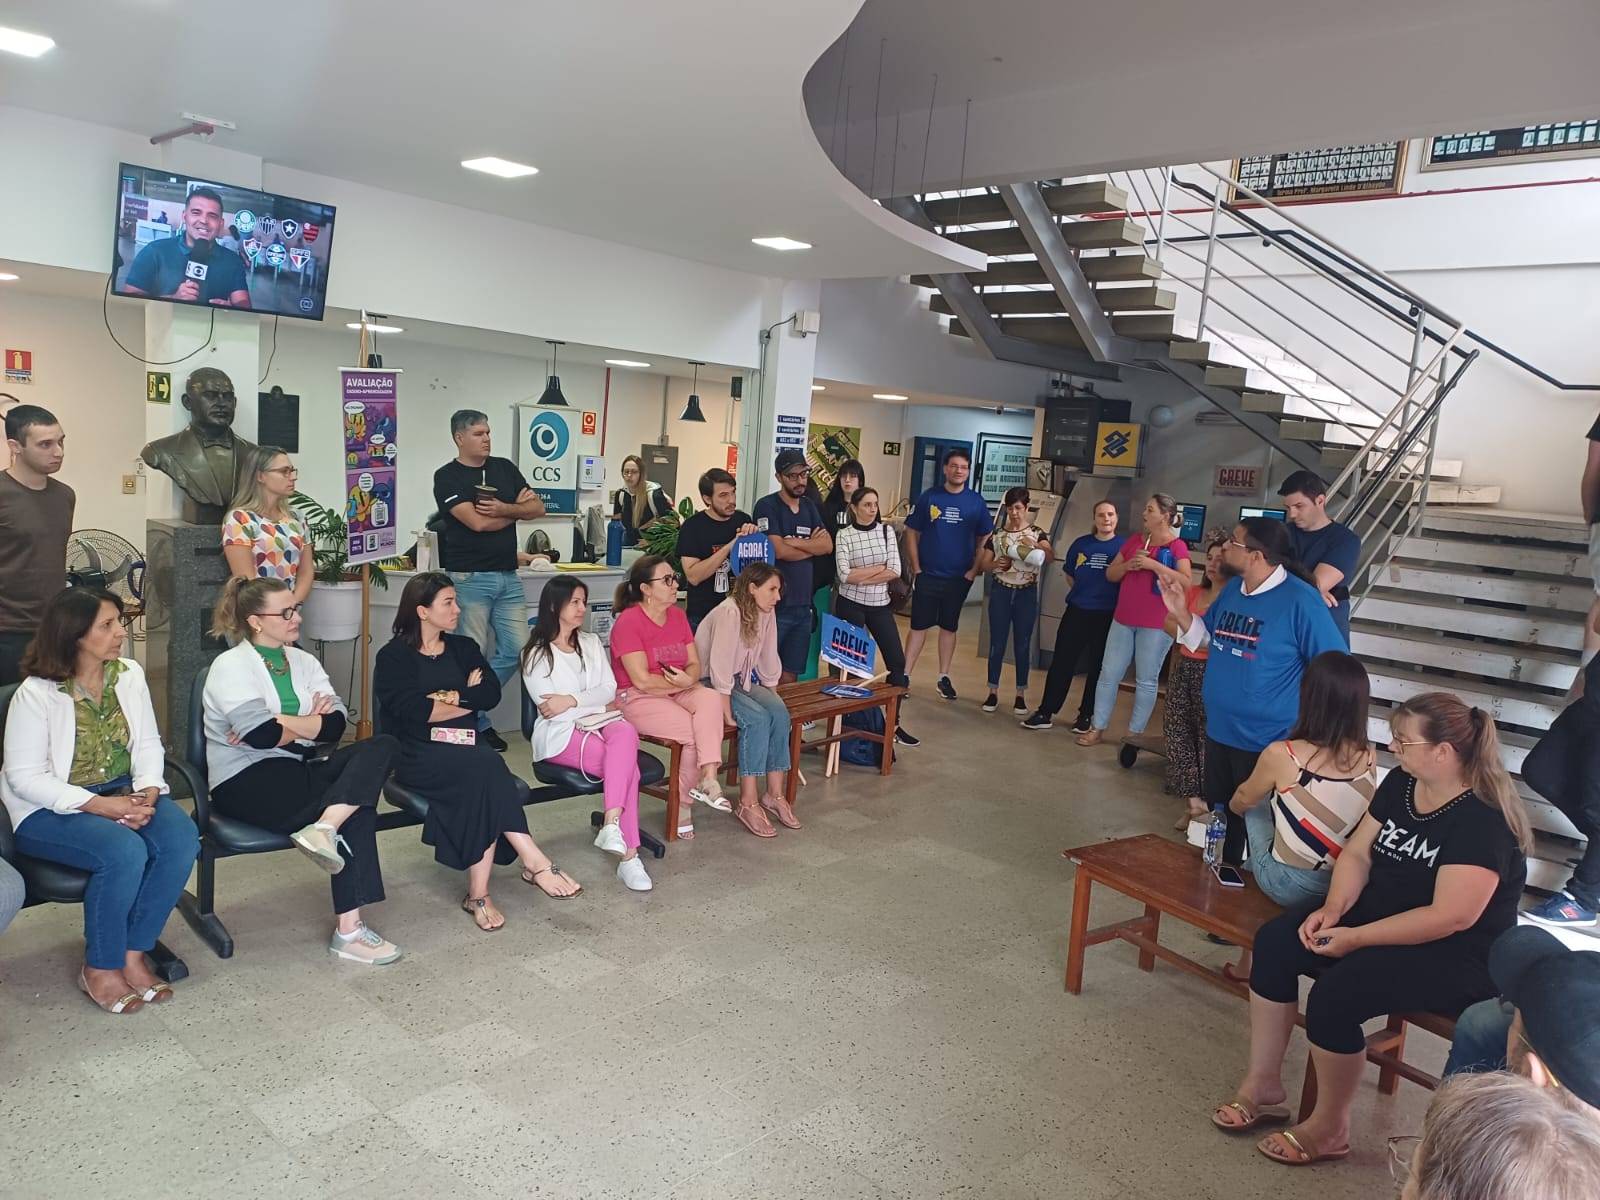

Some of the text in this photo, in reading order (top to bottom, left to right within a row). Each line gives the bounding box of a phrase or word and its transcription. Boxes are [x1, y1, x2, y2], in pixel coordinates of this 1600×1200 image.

[346, 377, 393, 389] AVALIAÇÃO
[532, 466, 561, 482] CCS
[1219, 468, 1256, 488] GREVE
[738, 542, 763, 558] AGORA
[763, 539, 769, 558] É
[831, 626, 870, 665] GREVE
[1378, 818, 1441, 868] REAM
